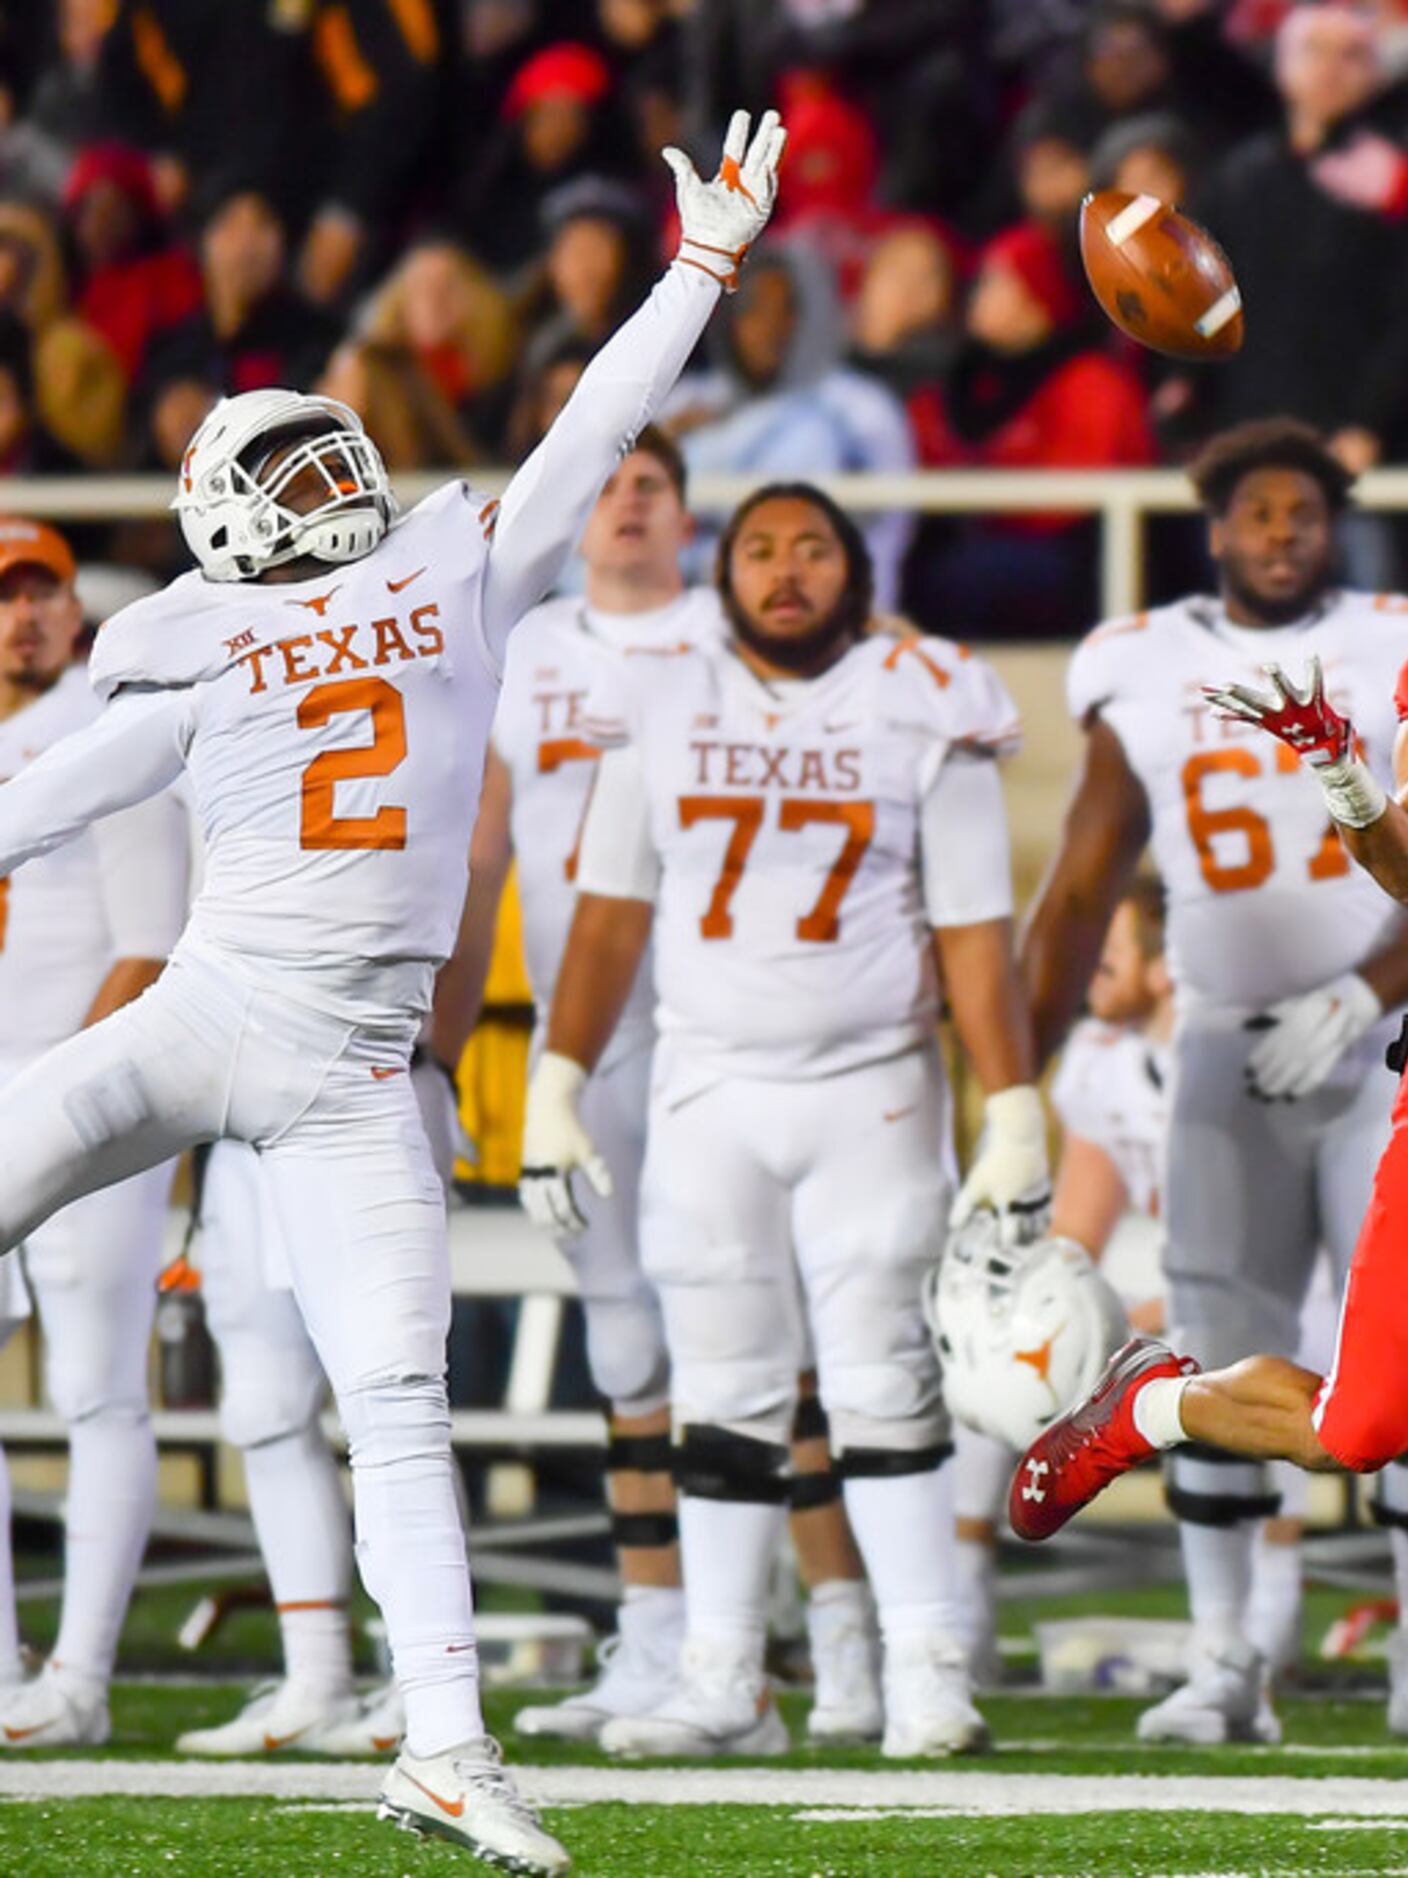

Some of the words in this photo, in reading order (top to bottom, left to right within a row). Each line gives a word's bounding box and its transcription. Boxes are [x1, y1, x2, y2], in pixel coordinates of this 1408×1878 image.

[238, 603, 446, 694] TEXAS
[297, 676, 409, 850] 2
[690, 741, 863, 791] TEXAS
[678, 796, 876, 942] 77
